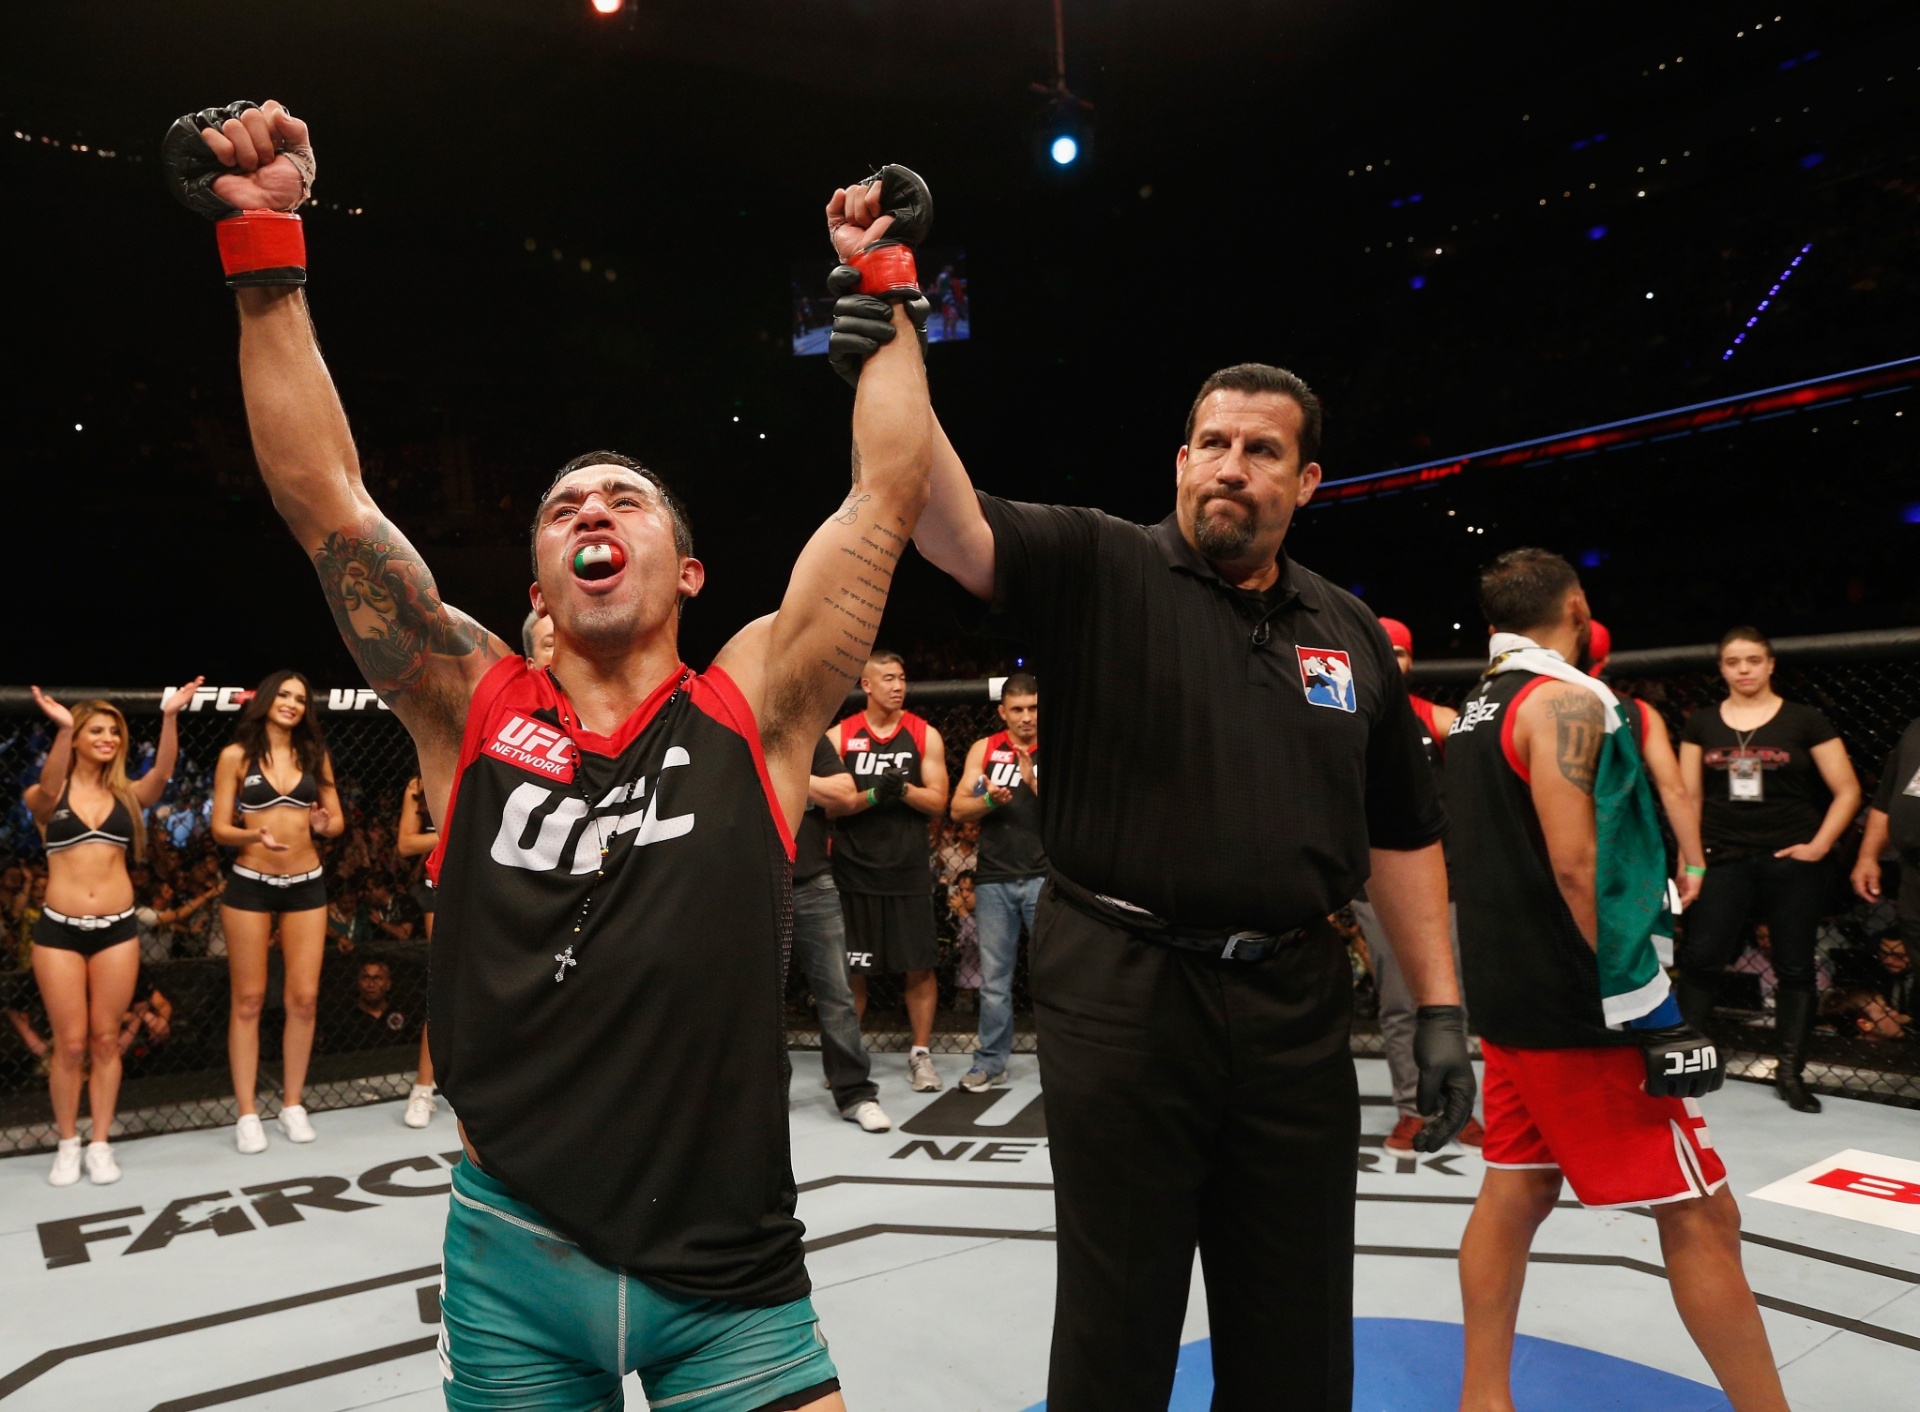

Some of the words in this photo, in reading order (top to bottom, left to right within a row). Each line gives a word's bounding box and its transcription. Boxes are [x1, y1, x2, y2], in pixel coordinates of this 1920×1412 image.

[497, 716, 576, 765] UFC
[490, 742, 567, 776] NETWORK
[855, 752, 913, 775] UFC
[490, 745, 695, 875] UFC
[1664, 1046, 1718, 1076] UFC
